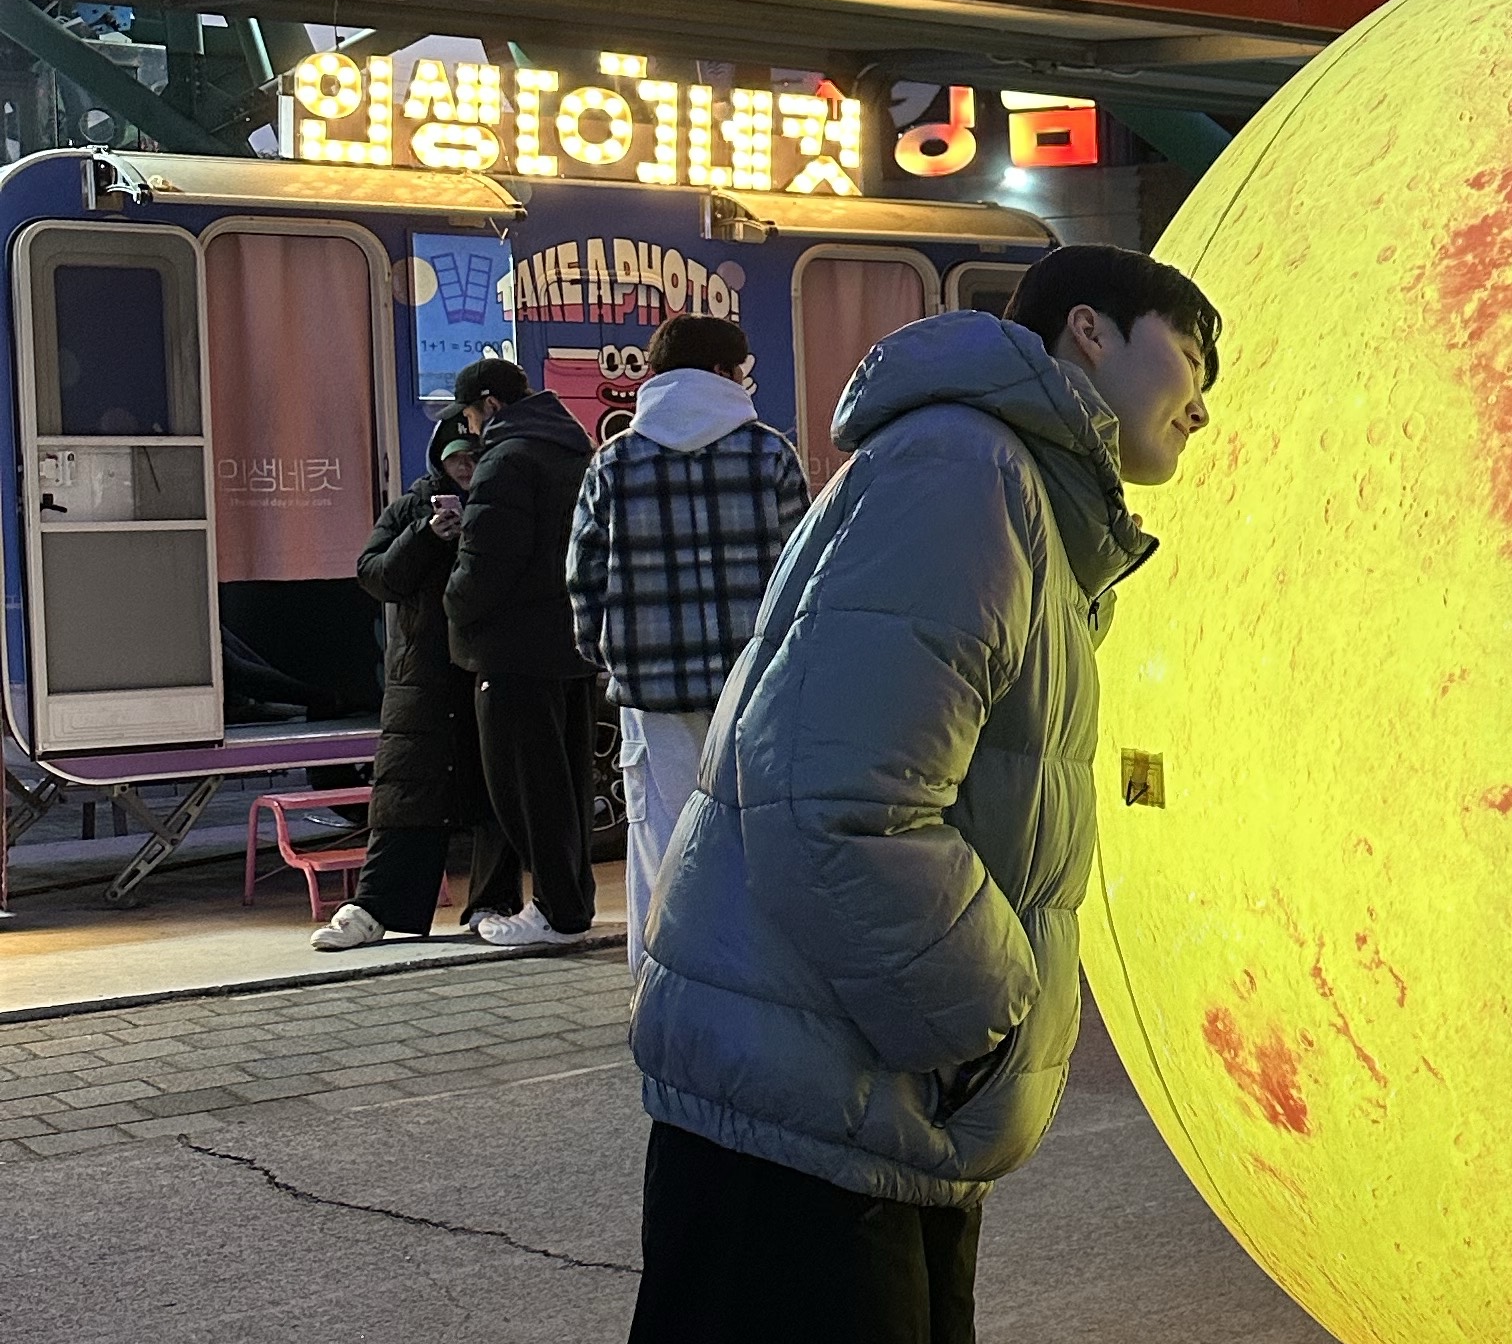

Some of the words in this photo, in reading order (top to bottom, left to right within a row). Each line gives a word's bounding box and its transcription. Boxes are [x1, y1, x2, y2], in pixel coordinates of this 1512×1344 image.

[496, 240, 584, 323] TAKE
[587, 238, 616, 323] A
[613, 238, 740, 325] PHOTO!
[420, 339, 446, 353] 1+1
[217, 458, 343, 492] 인생네컷
